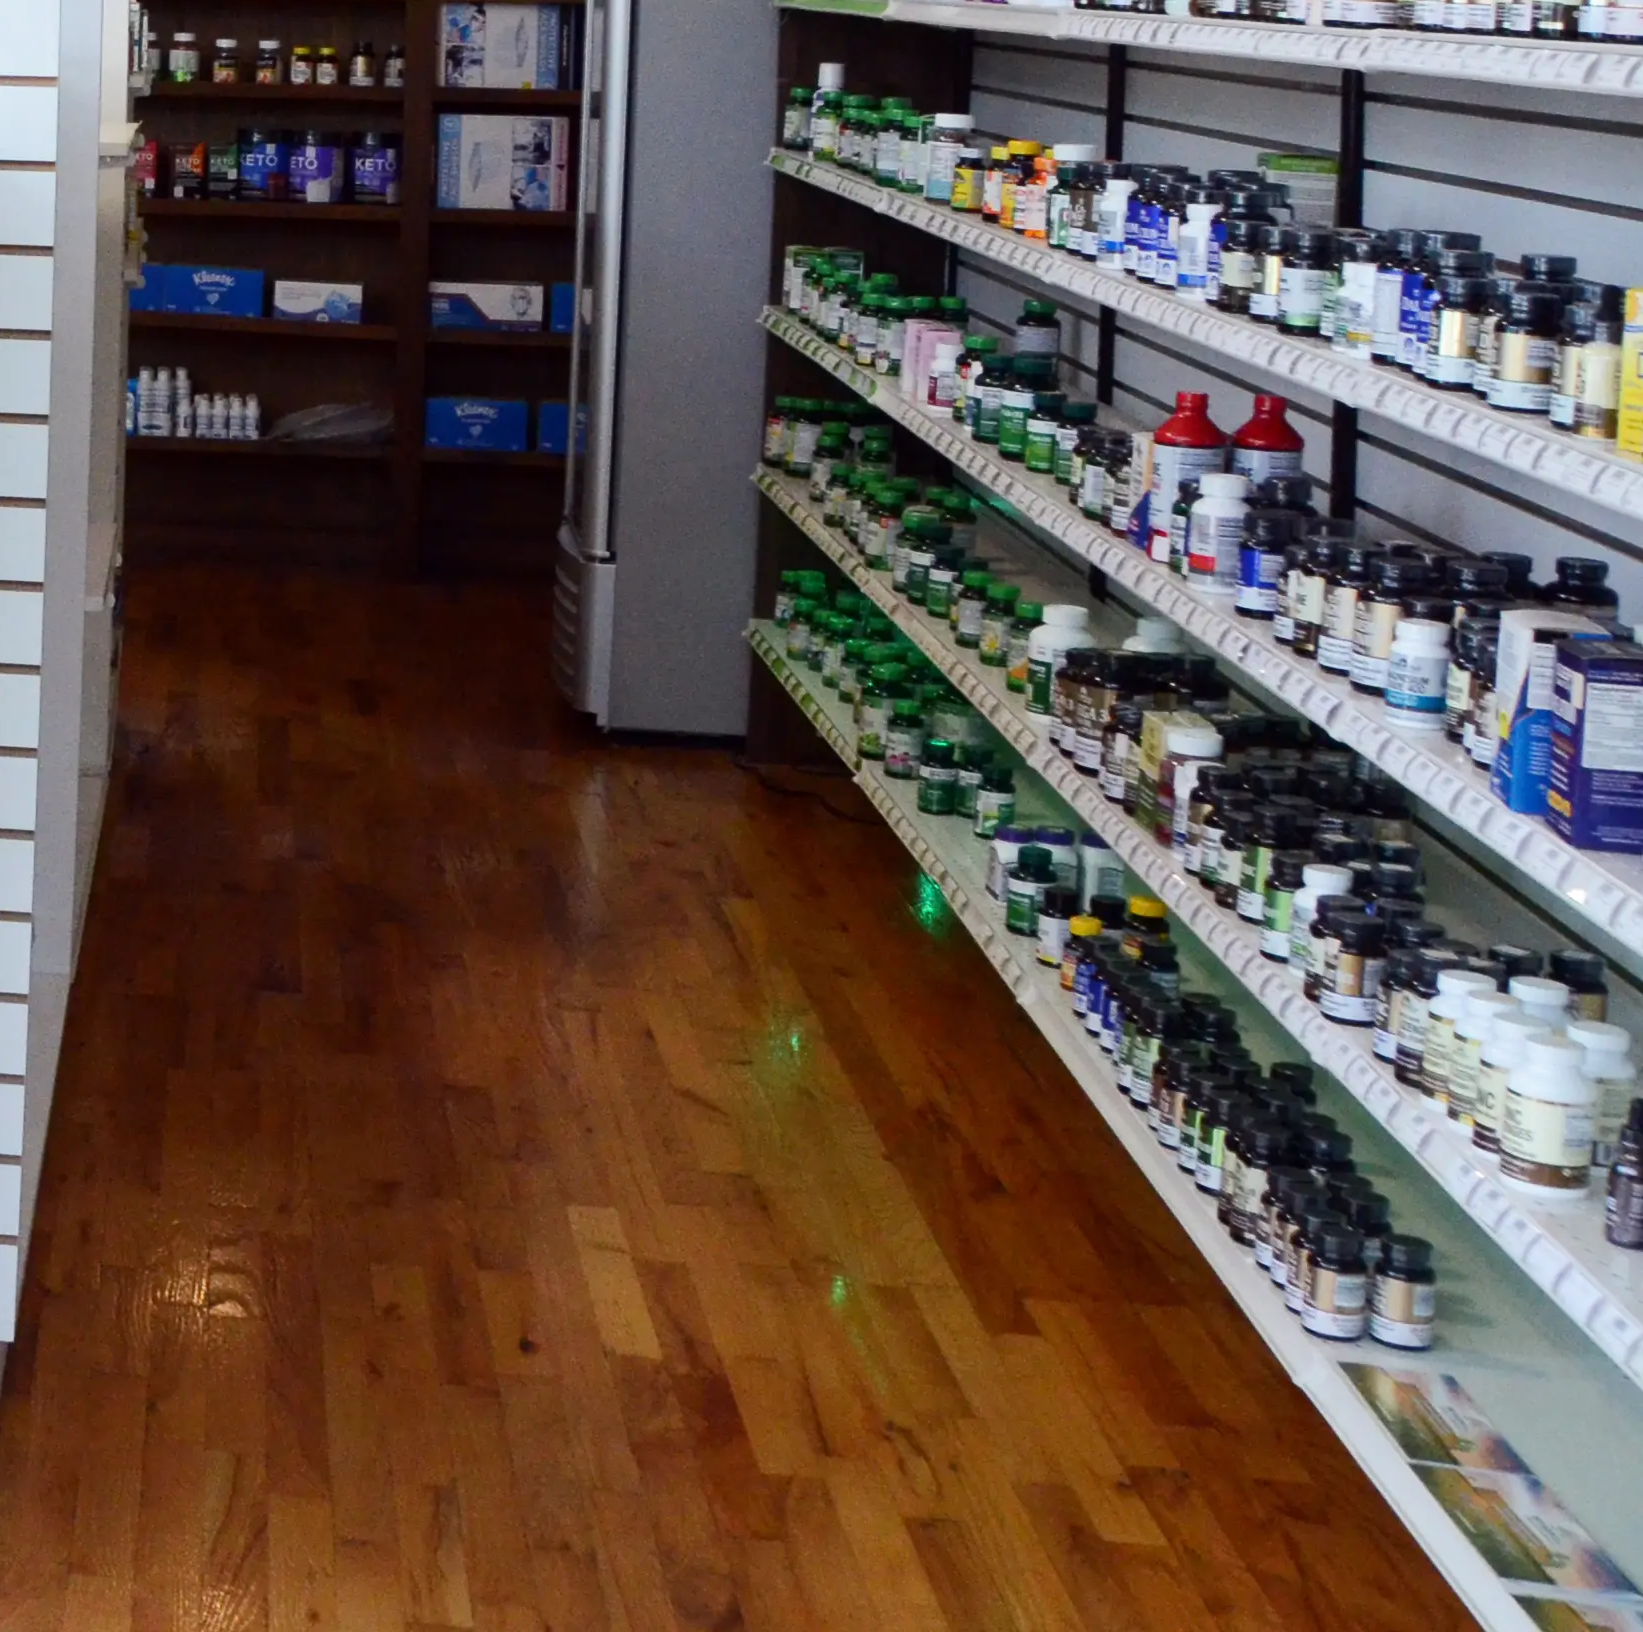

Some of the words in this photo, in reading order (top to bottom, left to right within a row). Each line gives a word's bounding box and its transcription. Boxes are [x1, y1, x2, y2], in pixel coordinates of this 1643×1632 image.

[176, 157, 200, 166] KETO
[210, 158, 235, 166] KETO
[290, 155, 318, 169] ETO
[355, 158, 397, 171] KETO
